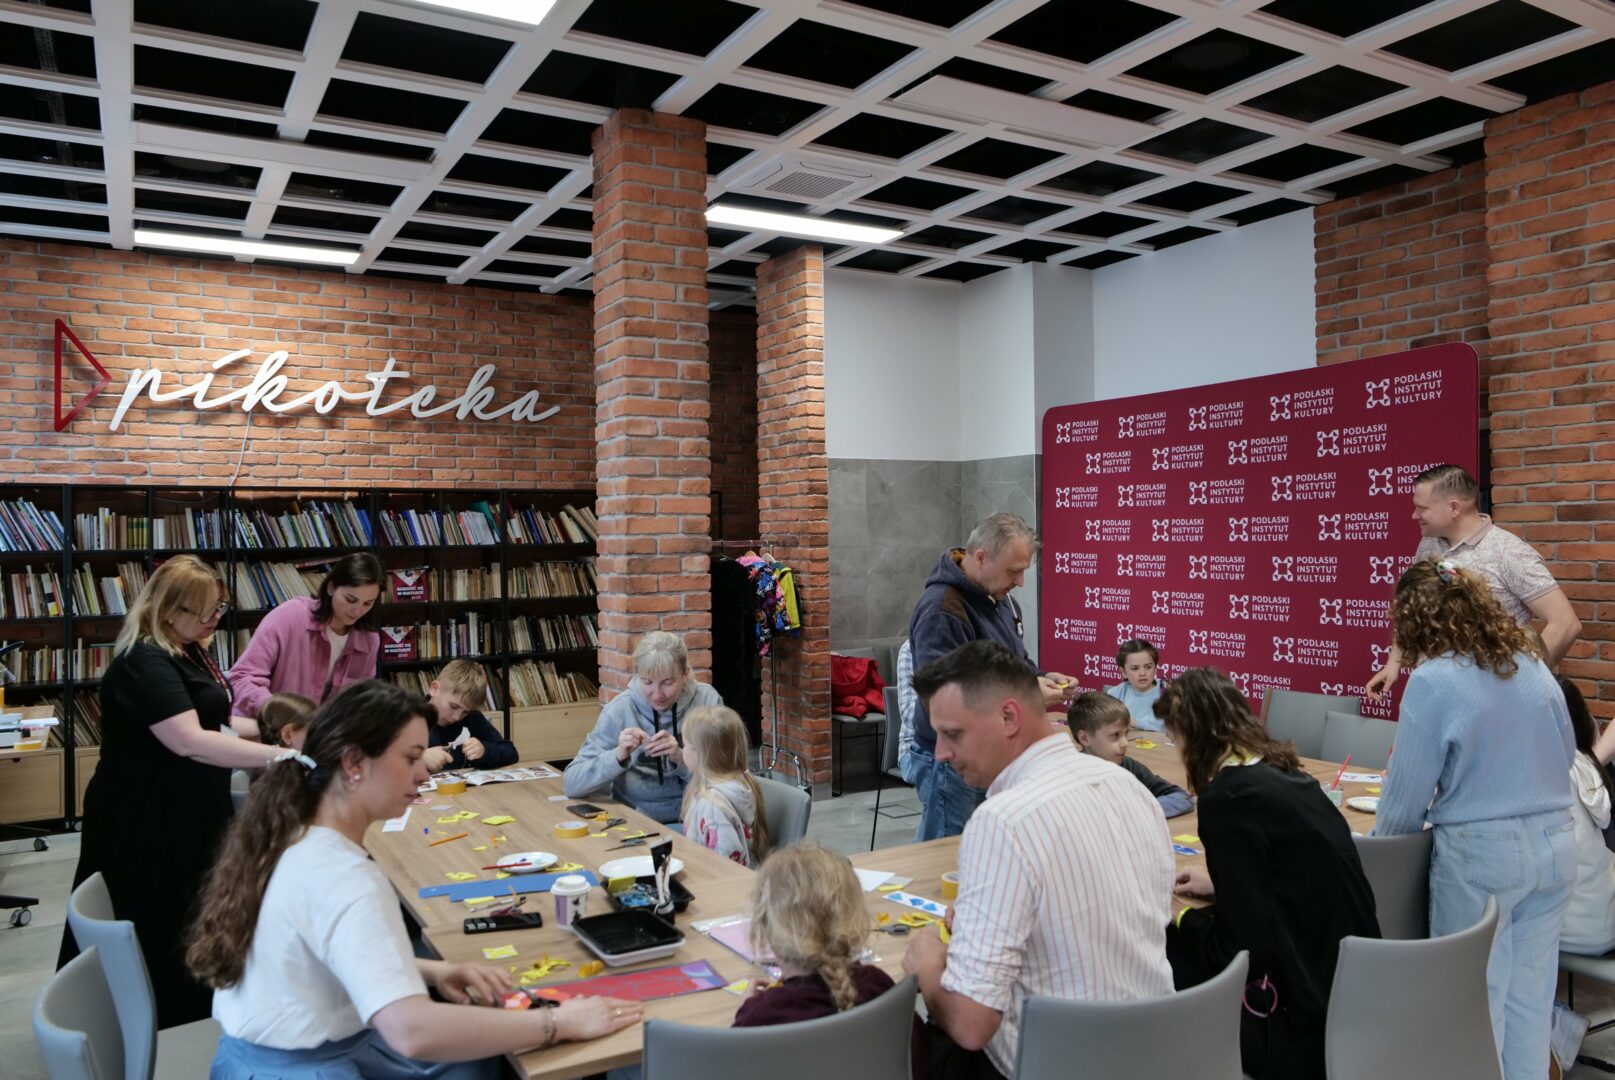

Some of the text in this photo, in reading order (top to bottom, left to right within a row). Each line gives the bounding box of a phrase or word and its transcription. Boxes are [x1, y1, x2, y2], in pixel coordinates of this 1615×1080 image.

[1394, 369, 1442, 385] PODLASKI
[109, 348, 561, 431] pikoteka
[1394, 379, 1442, 395] INSTYTUT
[1294, 387, 1334, 400] PODLASKI
[1395, 390, 1442, 405] KULTURY
[1209, 401, 1244, 412] PODLASKI
[1294, 396, 1334, 410] INSTYTUT
[1136, 412, 1166, 421] PODLASKI
[1209, 409, 1244, 420] INSTYTUT
[1294, 406, 1334, 418] KULTURY
[1072, 420, 1099, 428] PODLASKI
[1136, 419, 1166, 429] INSTYTUT
[1209, 418, 1243, 429] KULTURY
[1072, 427, 1098, 435] INSTYTUT
[1136, 427, 1166, 437] KULTURY
[1343, 423, 1387, 436] PODLASKI
[1250, 435, 1288, 446] PODLASKI
[1343, 433, 1387, 446] INSTYTUT
[1171, 444, 1204, 453] PODLASKI
[1250, 444, 1288, 454] INSTYTUT
[1343, 443, 1387, 455] KULTURY
[1102, 450, 1131, 459] PODLASKI
[1171, 452, 1203, 461] INSTYTUT
[1250, 453, 1288, 463] KULTURY
[1102, 458, 1131, 466] INSTYTUT
[1171, 460, 1203, 469] KULTURY
[1102, 466, 1131, 474] KULTURY
[1295, 472, 1336, 482] PODLASKI
[1210, 478, 1245, 487] PODLASKI
[1296, 481, 1336, 491] INSTYTUT
[1136, 491, 1166, 499] INSTYTUT
[1210, 487, 1244, 496] INSTYTUT
[1296, 490, 1336, 500] KULTURY
[1210, 496, 1244, 504] KULTURY
[1251, 516, 1289, 524] PODLASKI
[1344, 512, 1389, 521] PODLASKI
[1251, 524, 1289, 533] INSTYTUT
[1345, 521, 1389, 531] INSTYTUT
[1251, 533, 1289, 542] KULTURY
[1345, 531, 1388, 540] KULTURY
[1296, 556, 1338, 564] PODLASKI
[1296, 565, 1337, 574] INSTYTUT
[1210, 572, 1245, 580] KULTURY
[1296, 574, 1337, 583] KULTURY
[1102, 587, 1131, 596] PODLASKI
[1171, 591, 1204, 600] PODLASKI
[1102, 595, 1130, 603] INSTYTUT
[1252, 595, 1290, 604] PODLASKI
[1346, 599, 1390, 608] PODLASKI
[1102, 602, 1130, 611] KULTURY
[1171, 600, 1204, 608] INSTYTUT
[1252, 604, 1290, 613] INSTYTUT
[1171, 608, 1204, 616] KULTURY
[1252, 613, 1290, 622] KULTURY
[1070, 619, 1097, 627] PODLASKI
[1346, 618, 1390, 628] KULTURY
[1070, 626, 1097, 635] INSTYTUT
[1135, 624, 1166, 634] PODLASKI
[1070, 634, 1096, 642] KULTURY
[1135, 632, 1165, 641] INSTYTUT
[1210, 631, 1246, 641] PODLASKI
[1210, 639, 1246, 649] INSTYTUT
[1297, 638, 1339, 649] PODLASKI
[1210, 648, 1245, 658] KULTURY
[1297, 647, 1338, 658] INSTYTUT
[1297, 656, 1338, 667] KULTURY
[1102, 670, 1121, 679] KULTU
[1252, 674, 1291, 685] PODLASKI
[1361, 706, 1392, 717] LTURY
